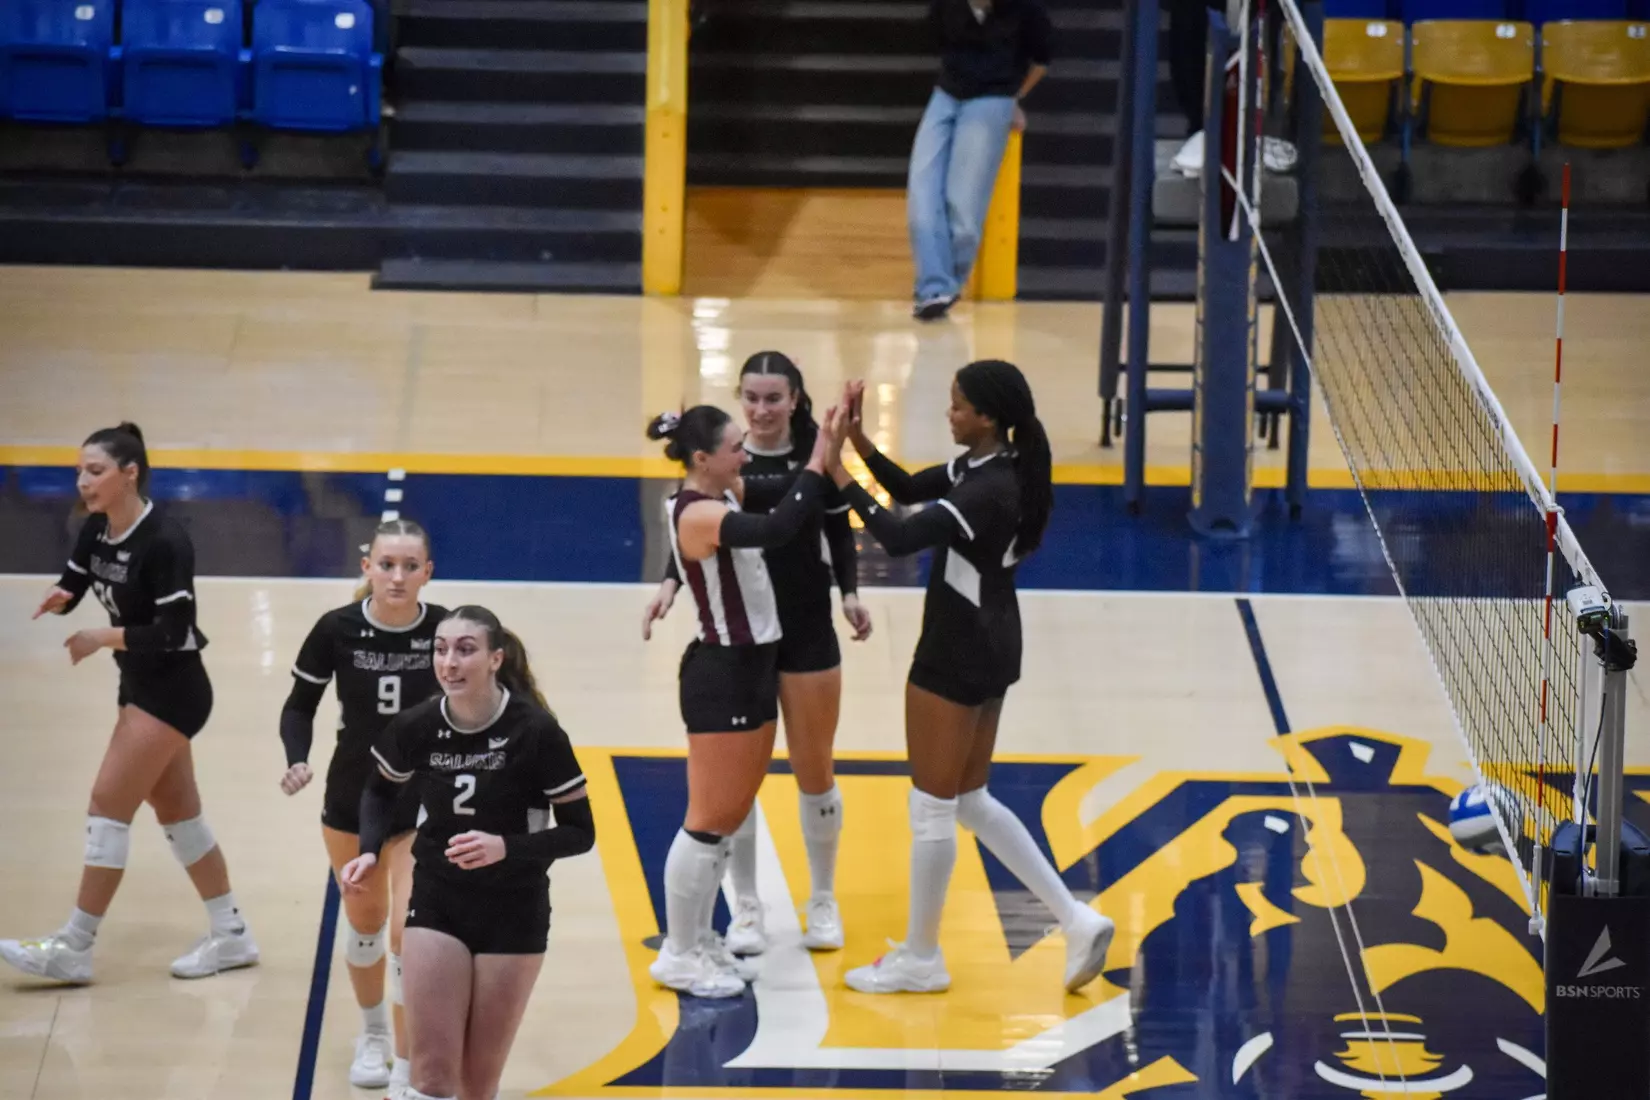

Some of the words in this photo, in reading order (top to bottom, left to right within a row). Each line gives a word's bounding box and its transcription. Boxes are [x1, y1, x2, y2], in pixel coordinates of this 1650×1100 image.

[377, 675, 401, 715] 9
[429, 751, 506, 771] SALUKIS
[453, 774, 476, 816] 2
